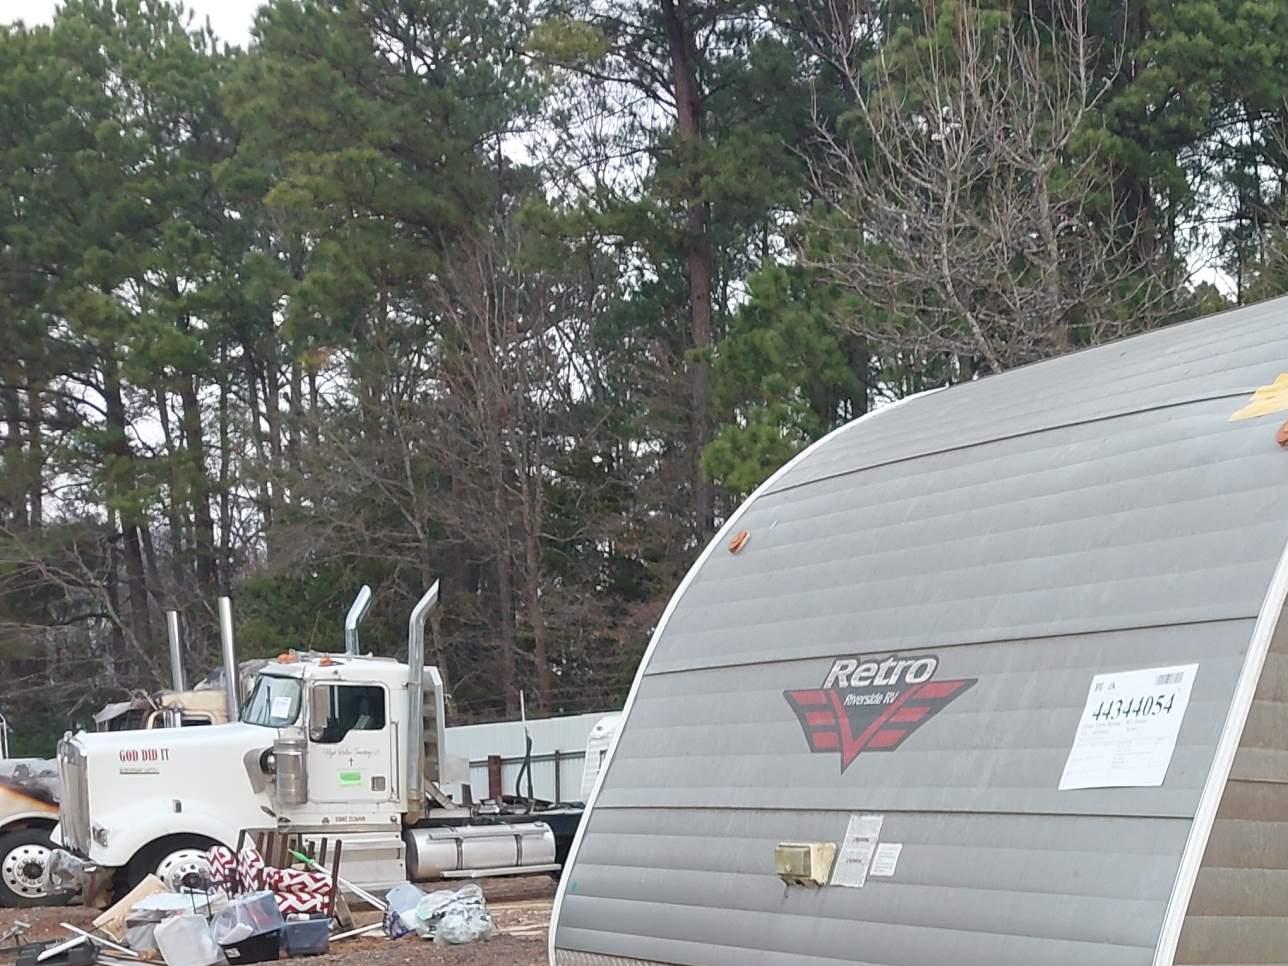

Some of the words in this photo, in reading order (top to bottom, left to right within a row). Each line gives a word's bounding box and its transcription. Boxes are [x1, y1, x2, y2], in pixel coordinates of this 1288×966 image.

[823, 656, 938, 689] Retro
[843, 692, 883, 707] Riverside
[883, 691, 900, 705] RV
[1092, 693, 1176, 721] 44344054
[119, 749, 139, 762] GOD
[141, 748, 158, 762] DID
[160, 747, 169, 761] IT
